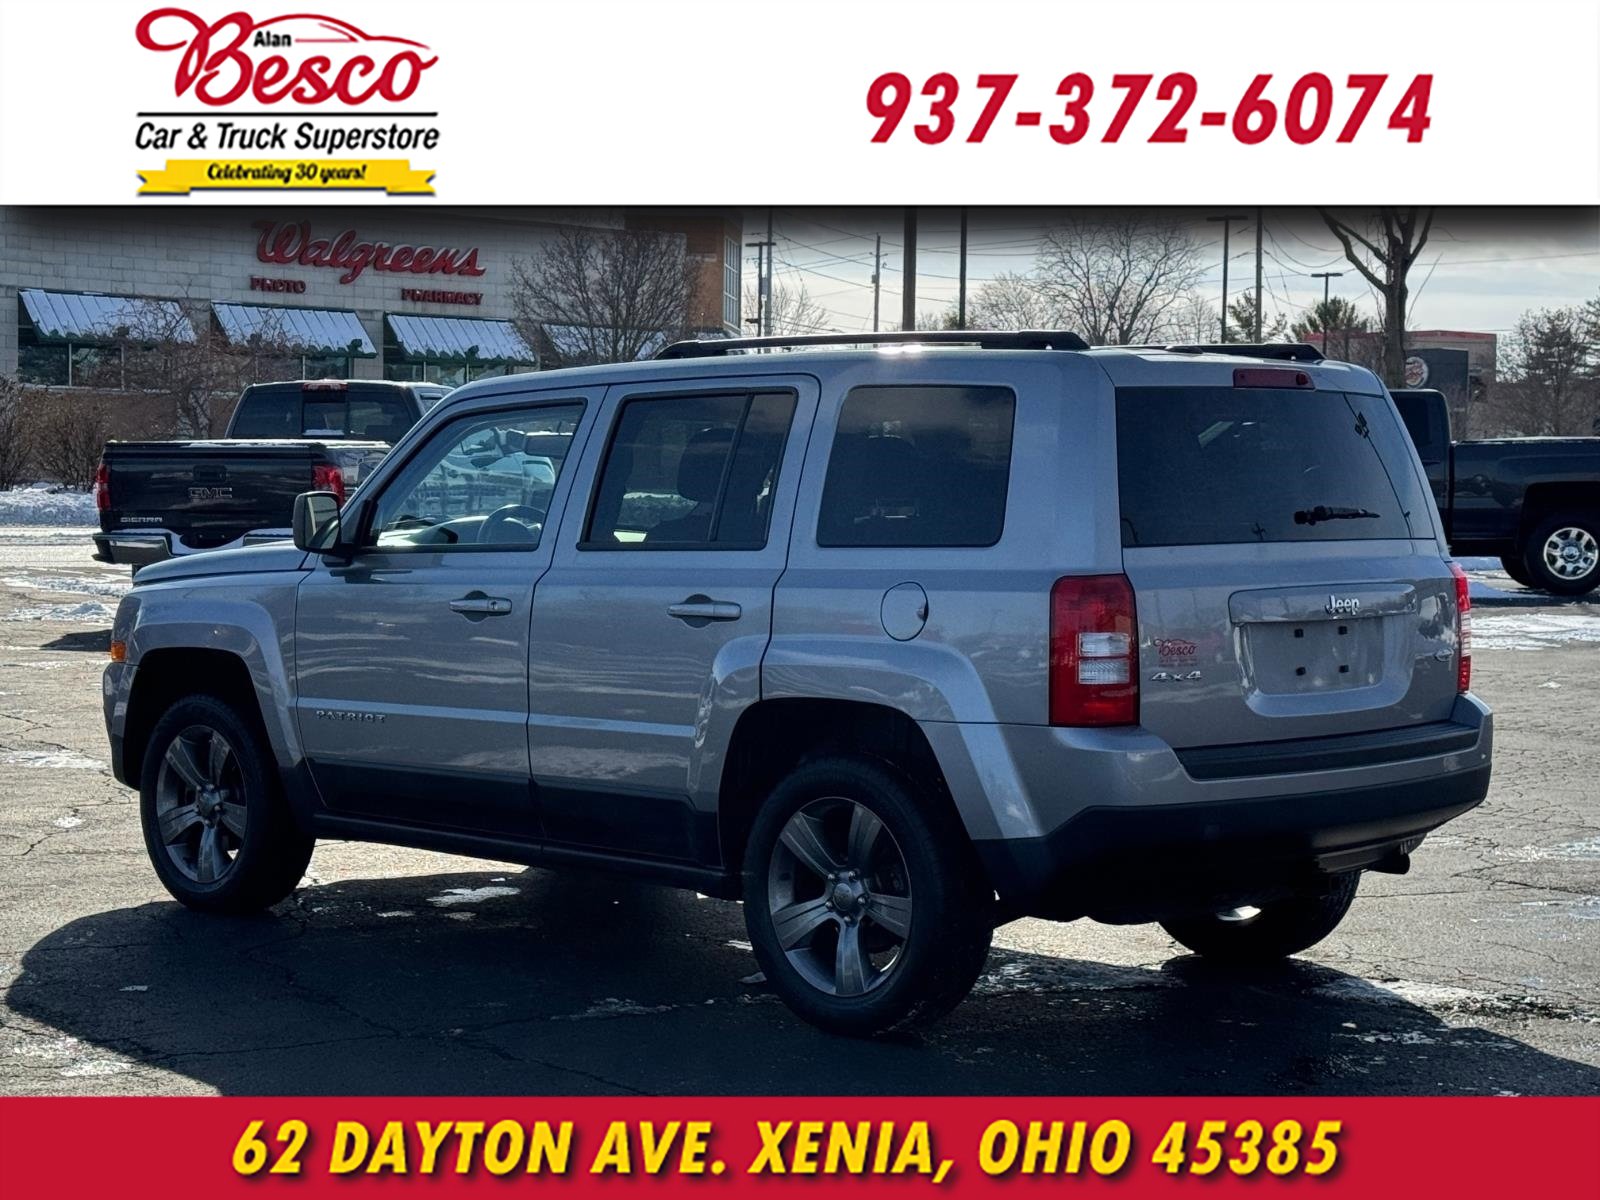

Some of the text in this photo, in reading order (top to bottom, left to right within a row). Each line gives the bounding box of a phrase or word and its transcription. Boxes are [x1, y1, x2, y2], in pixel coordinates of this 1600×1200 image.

[253, 219, 487, 285] Walgreens
[250, 275, 306, 294] PHOTO
[401, 288, 484, 305] PHARMACY
[188, 487, 233, 499] GMC
[120, 515, 163, 523] SIERRA
[1325, 595, 1360, 616] Jeep
[1153, 638, 1199, 657] Besco
[316, 710, 386, 723] PATRIOT
